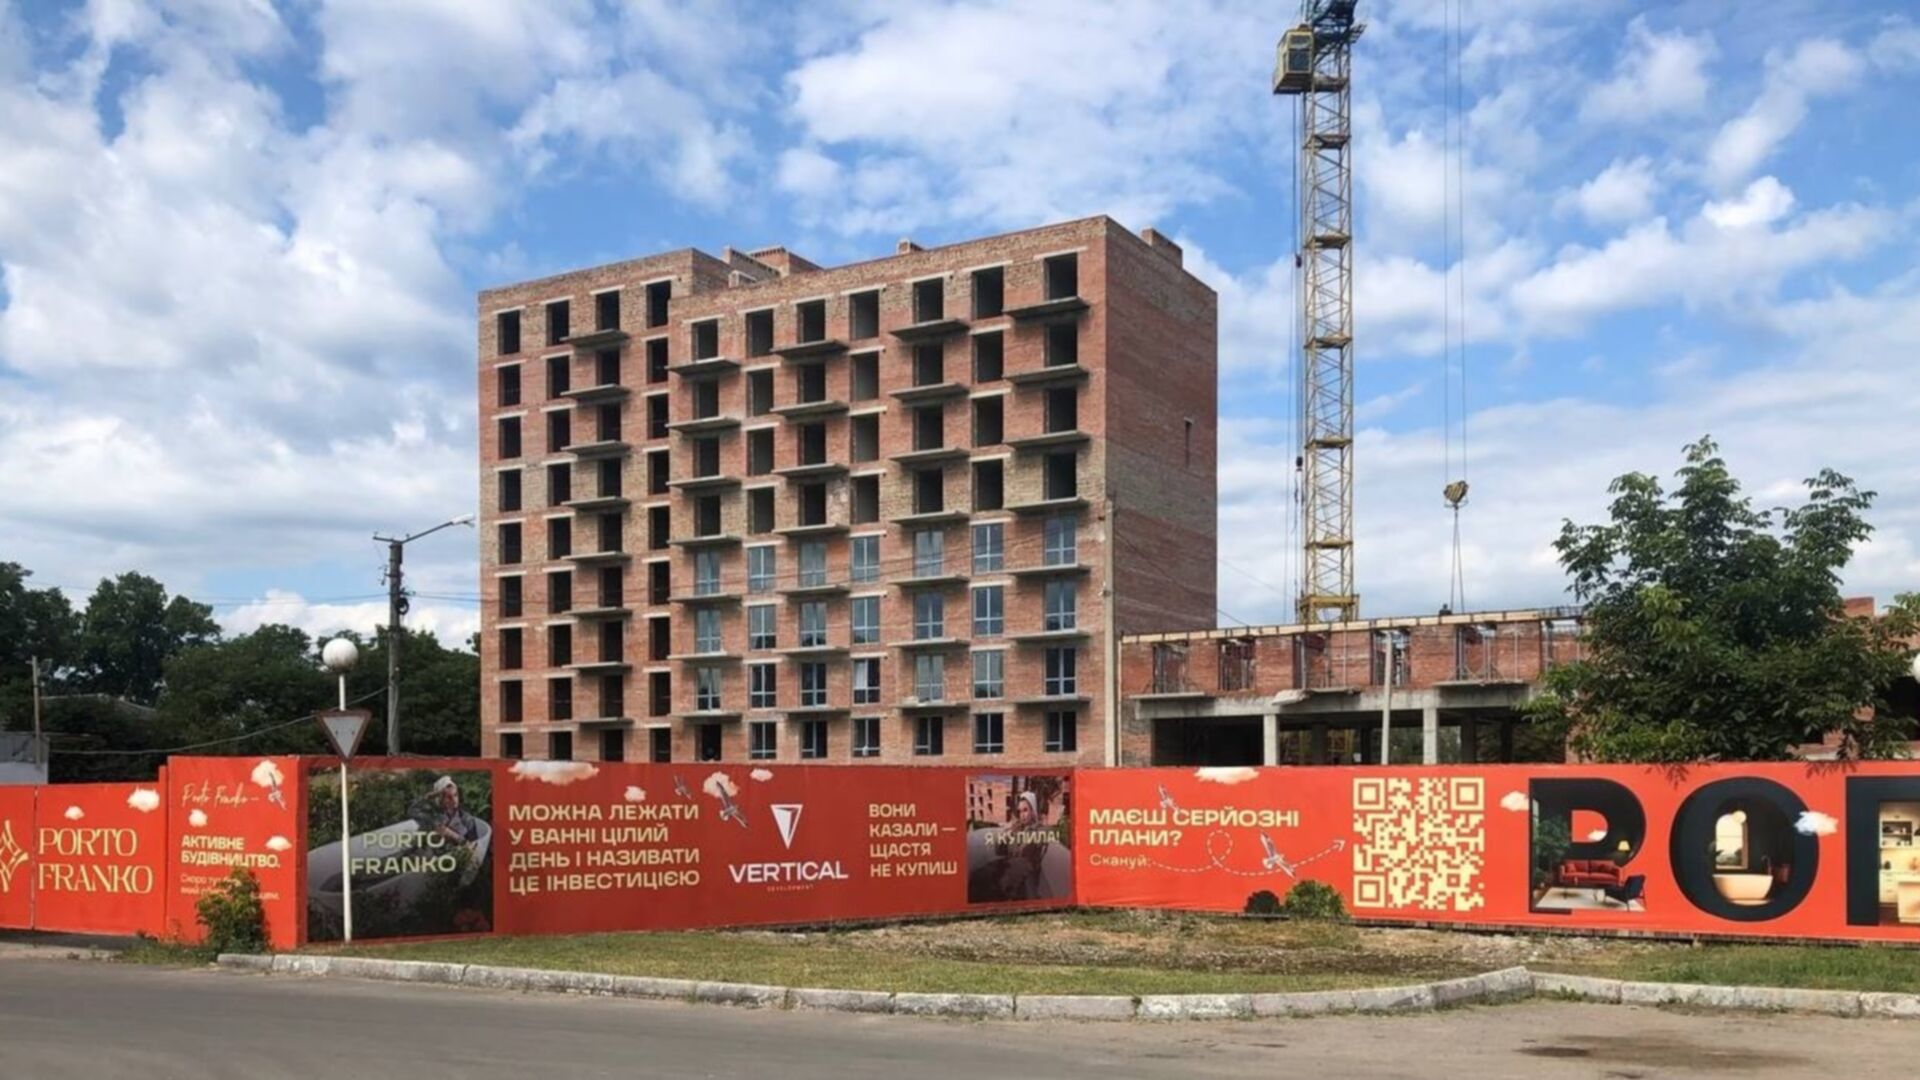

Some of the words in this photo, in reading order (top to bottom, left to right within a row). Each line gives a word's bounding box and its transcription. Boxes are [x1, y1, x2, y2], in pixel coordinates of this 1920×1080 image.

[509, 804, 602, 821] МОЖНА
[608, 804, 699, 821] ЛЕЖАТИ
[869, 803, 916, 818] ВОНИ
[1089, 809, 1166, 825] МАЄШ
[1173, 806, 1299, 827] СЕРЙОЗНІ
[509, 829, 524, 845] У
[530, 828, 596, 845] ВАННІ
[602, 823, 669, 846] ЦІЛИЙ
[869, 822, 938, 838] КАЗАЛИ
[985, 832, 994, 846] Я
[998, 830, 1060, 846] КУПИЛА!
[1089, 829, 1183, 847] ПЛАНИ?
[38, 827, 138, 857] PORTO
[181, 835, 244, 850] АКТИВНЕ
[363, 831, 445, 849] PORTO
[181, 850, 281, 868] БУДІВНИЦТВО.
[509, 851, 570, 872] ДЕНЬ
[576, 851, 581, 867] І
[587, 848, 700, 867] НАЗИВАТИ
[870, 842, 931, 860] ЩАСТЯ
[351, 854, 456, 875] FRANKO
[870, 863, 891, 877] НЕ
[896, 861, 958, 877] КУПИШ
[1089, 853, 1152, 869] Скануй:
[38, 863, 154, 894] FRANKO
[728, 861, 849, 883] VERTICAL
[509, 876, 540, 896] ЦЕ
[547, 869, 700, 891] ІНВЕСТИЦІЄЮ
